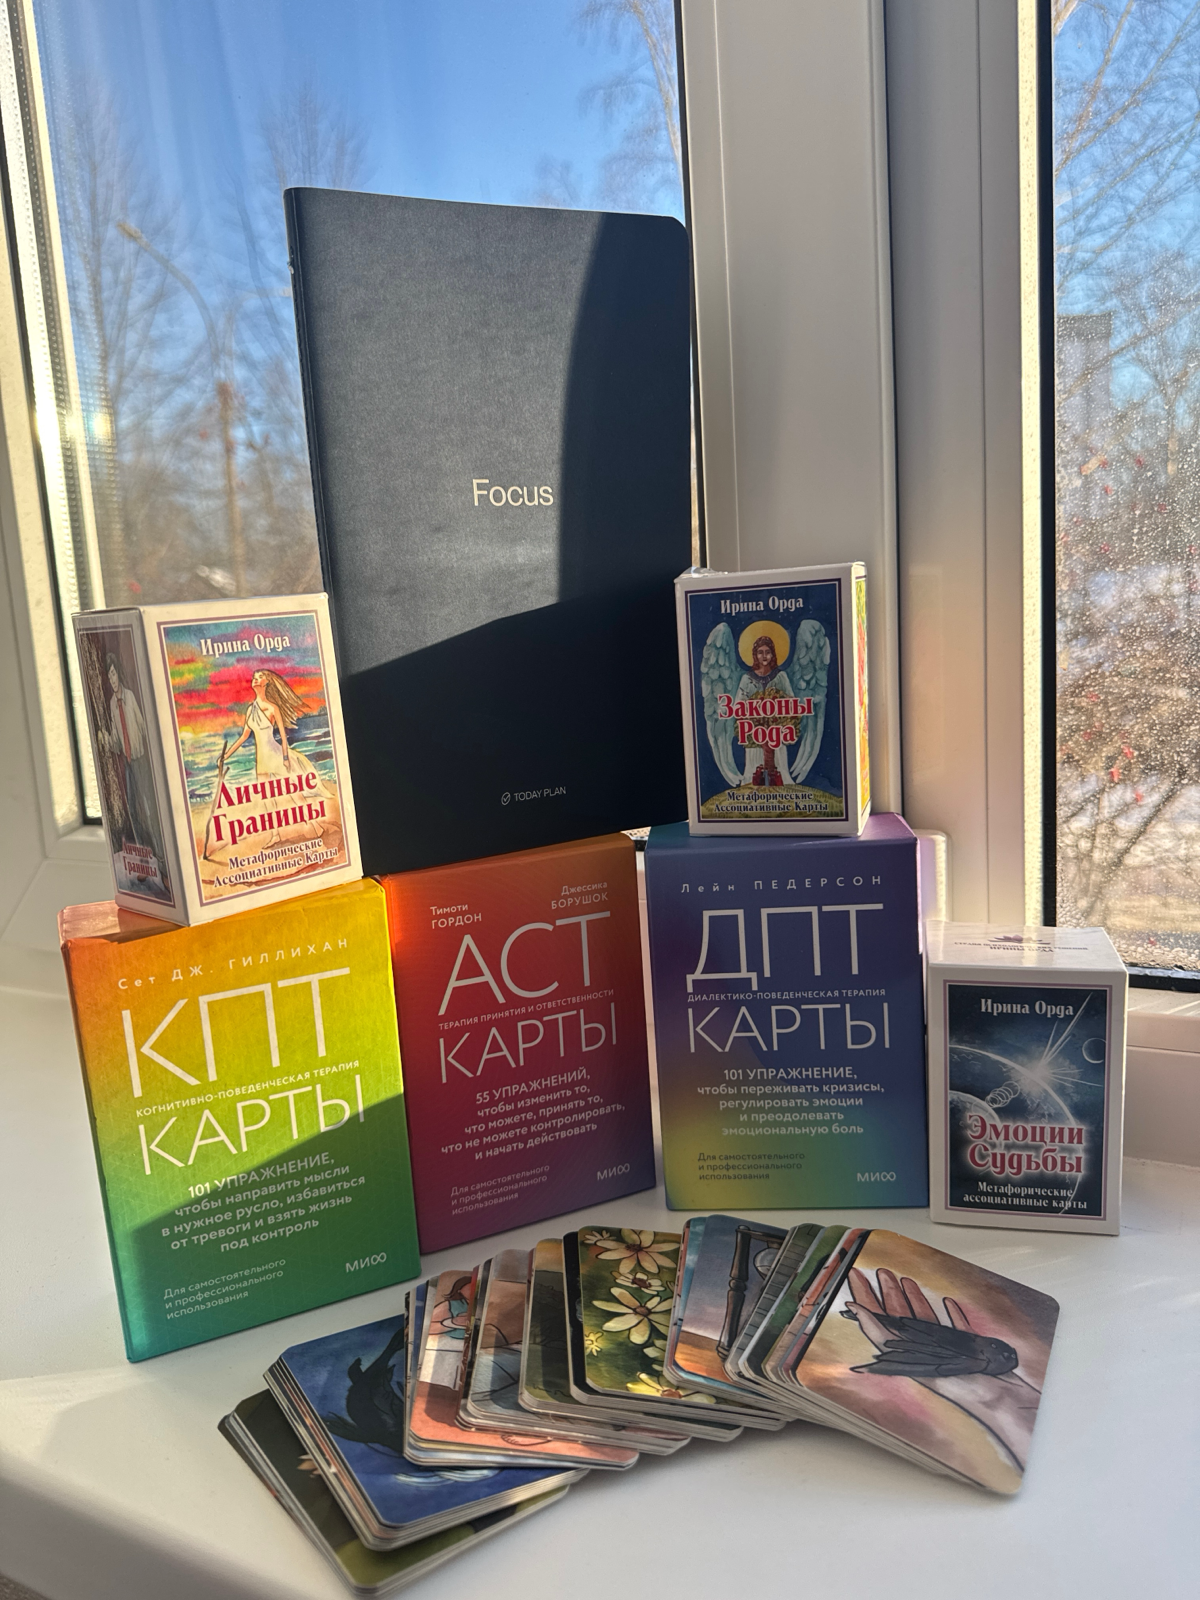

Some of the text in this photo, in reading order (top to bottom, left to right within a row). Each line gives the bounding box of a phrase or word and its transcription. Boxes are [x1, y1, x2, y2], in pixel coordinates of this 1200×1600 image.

[473, 479, 553, 506] Focus
[721, 596, 803, 616] Ирина Орда
[201, 634, 290, 658] Ирина Орда
[718, 695, 813, 719] Законы
[738, 720, 796, 749] Рода
[216, 771, 317, 809] Личные
[514, 786, 566, 801] TODAY PLAN
[727, 791, 812, 802] Метафорические
[715, 802, 828, 813] Ассоциативные Карты
[212, 800, 326, 845] Границы
[123, 856, 157, 877] Границы
[214, 848, 338, 887] Ассоциативные Карты
[229, 839, 322, 869] Метафорические
[561, 882, 607, 896] Джессика
[681, 876, 881, 892] Лейн ПЕДЕРСОН
[430, 904, 468, 915] Тимоти
[551, 892, 608, 909] БОРУШОК
[432, 913, 482, 929] ГОРДОН
[686, 904, 883, 992] ДПТ
[118, 976, 156, 989] Сет
[229, 938, 348, 969] ГИЛЛИХАН
[439, 1016, 478, 1030] ТЕРАПИЯ
[481, 1007, 525, 1022] ПРИНЯТИЯ
[536, 989, 614, 1011] ОТВЕТСТВЕННОСТИ
[688, 989, 886, 1002] ДИАЛЕКТИКО-ПОВЕДЕНЧЕСКАЯ ТЕРАПИЯ
[981, 999, 1074, 1018] Ирина Орда
[121, 967, 350, 1098] КПТ
[688, 1002, 890, 1052] КАРТЫ
[439, 1002, 617, 1083] КАРТЫ
[476, 1066, 591, 1104] 55 УПРАЖНЕНИЙ,
[724, 1066, 857, 1080] 101 УПРАЖНЕНИЕ,
[136, 1060, 359, 1118] КОГНИТИВНО-ПОВЕДЕНЧЕСКАЯ ТЕРАПИЯ
[478, 1084, 590, 1118] чтобы изменить то,
[698, 1082, 884, 1097] чтобы переживать кризисы,
[720, 1096, 863, 1110] регулировать эмоции
[139, 1074, 364, 1175] КАРТЫ
[441, 1103, 625, 1154] что не можете контролировать,
[465, 1095, 603, 1134] что можете, принять то,
[751, 1111, 844, 1123] преодолевать
[475, 1122, 597, 1160] и начать действовать
[722, 1123, 863, 1136] эмоциональную боль
[968, 1115, 1084, 1146] Эмоции
[698, 1153, 716, 1161] Для
[707, 1162, 802, 1171] профессионального
[969, 1143, 1082, 1176] Судьбы
[188, 1152, 334, 1198] 101 УПРАЖНЕНИЕ,
[451, 1165, 549, 1197] Для самостоятельного
[460, 1175, 547, 1204] профессионального
[978, 1182, 1072, 1197] Метафорические
[174, 1165, 349, 1217] чтобы направить мысли
[452, 1193, 518, 1215] использования
[963, 1194, 1087, 1208] ассоциативные карты
[162, 1176, 365, 1237] в нужное русло, избавиться
[171, 1195, 352, 1250] от тревоги и взять жизнь
[221, 1218, 319, 1252] под контроль
[164, 1259, 286, 1299] Для самостоятельного
[175, 1270, 283, 1306] профессионального
[167, 1291, 248, 1319] использования
